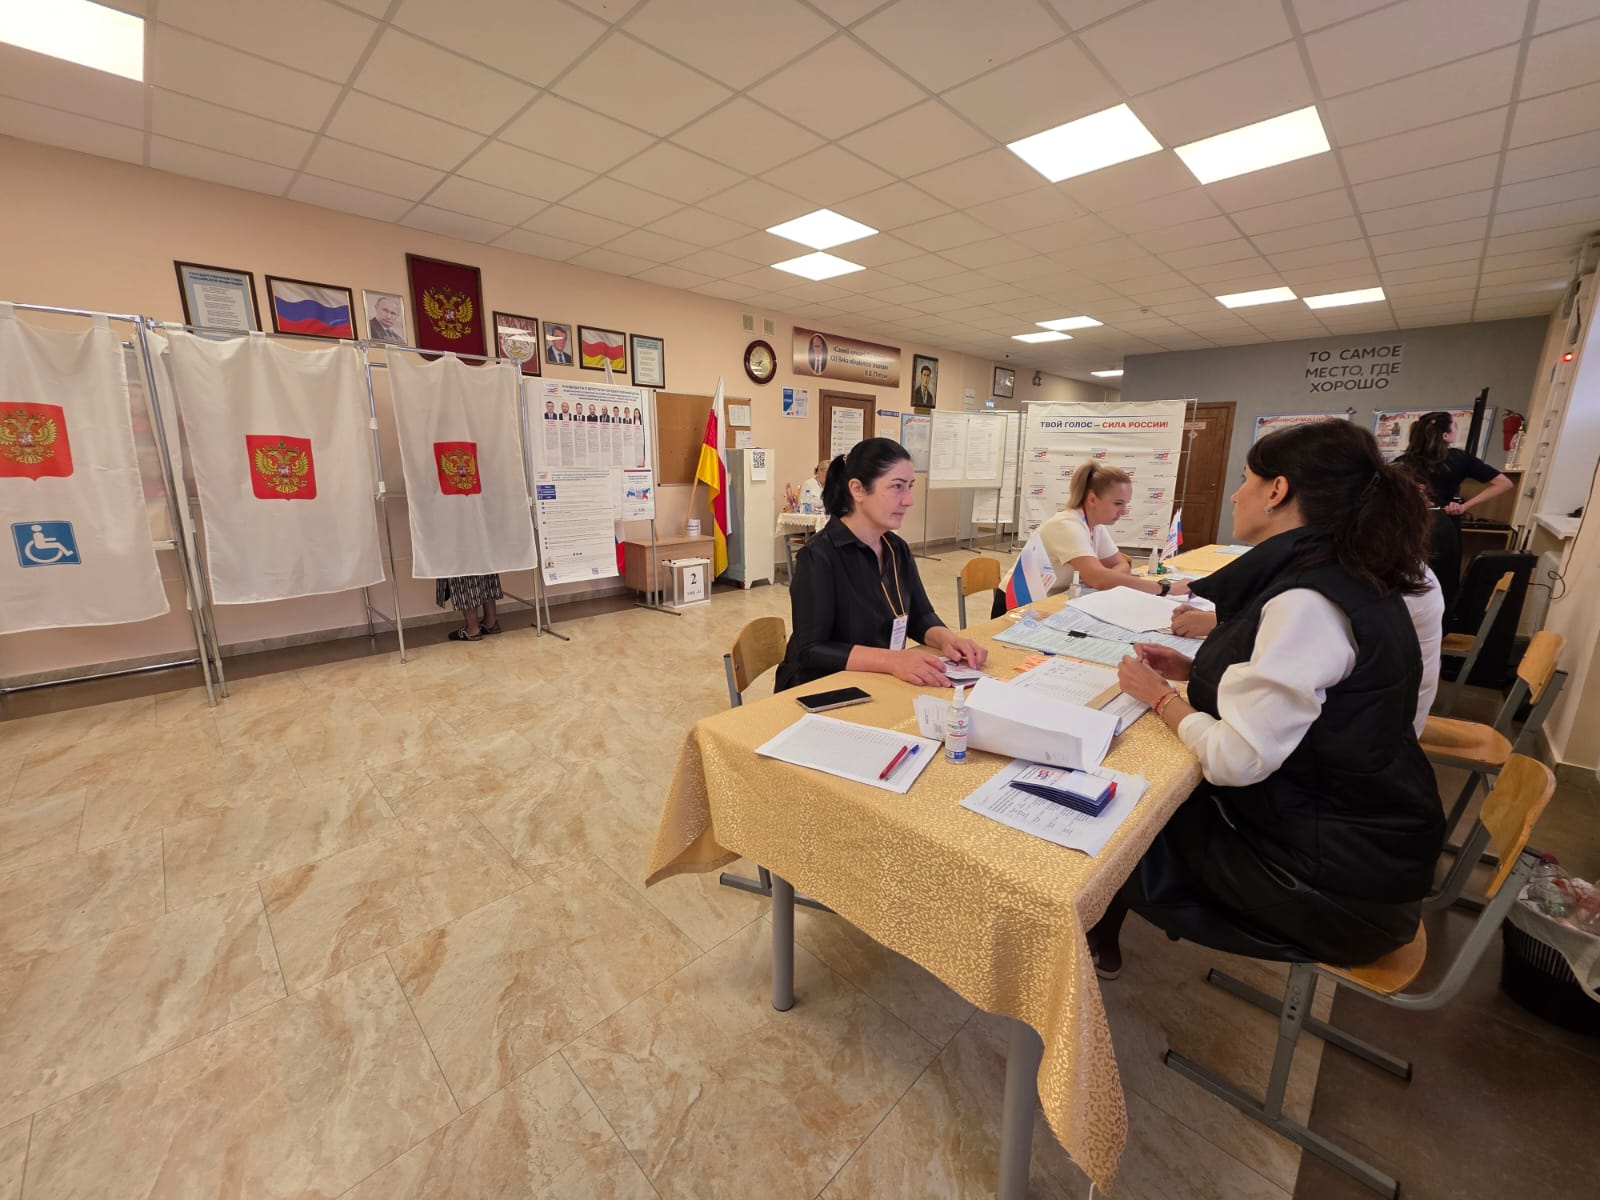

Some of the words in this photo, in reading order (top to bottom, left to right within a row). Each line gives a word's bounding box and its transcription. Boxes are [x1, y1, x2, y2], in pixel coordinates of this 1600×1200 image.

[1310, 351, 1331, 362] ТО
[1339, 345, 1402, 361] САМОЕ
[1305, 365, 1364, 379] МЕСТО,
[1370, 362, 1401, 377] ГДЕ
[1310, 378, 1389, 393] ХОРОШО
[690, 572, 697, 585] 2
